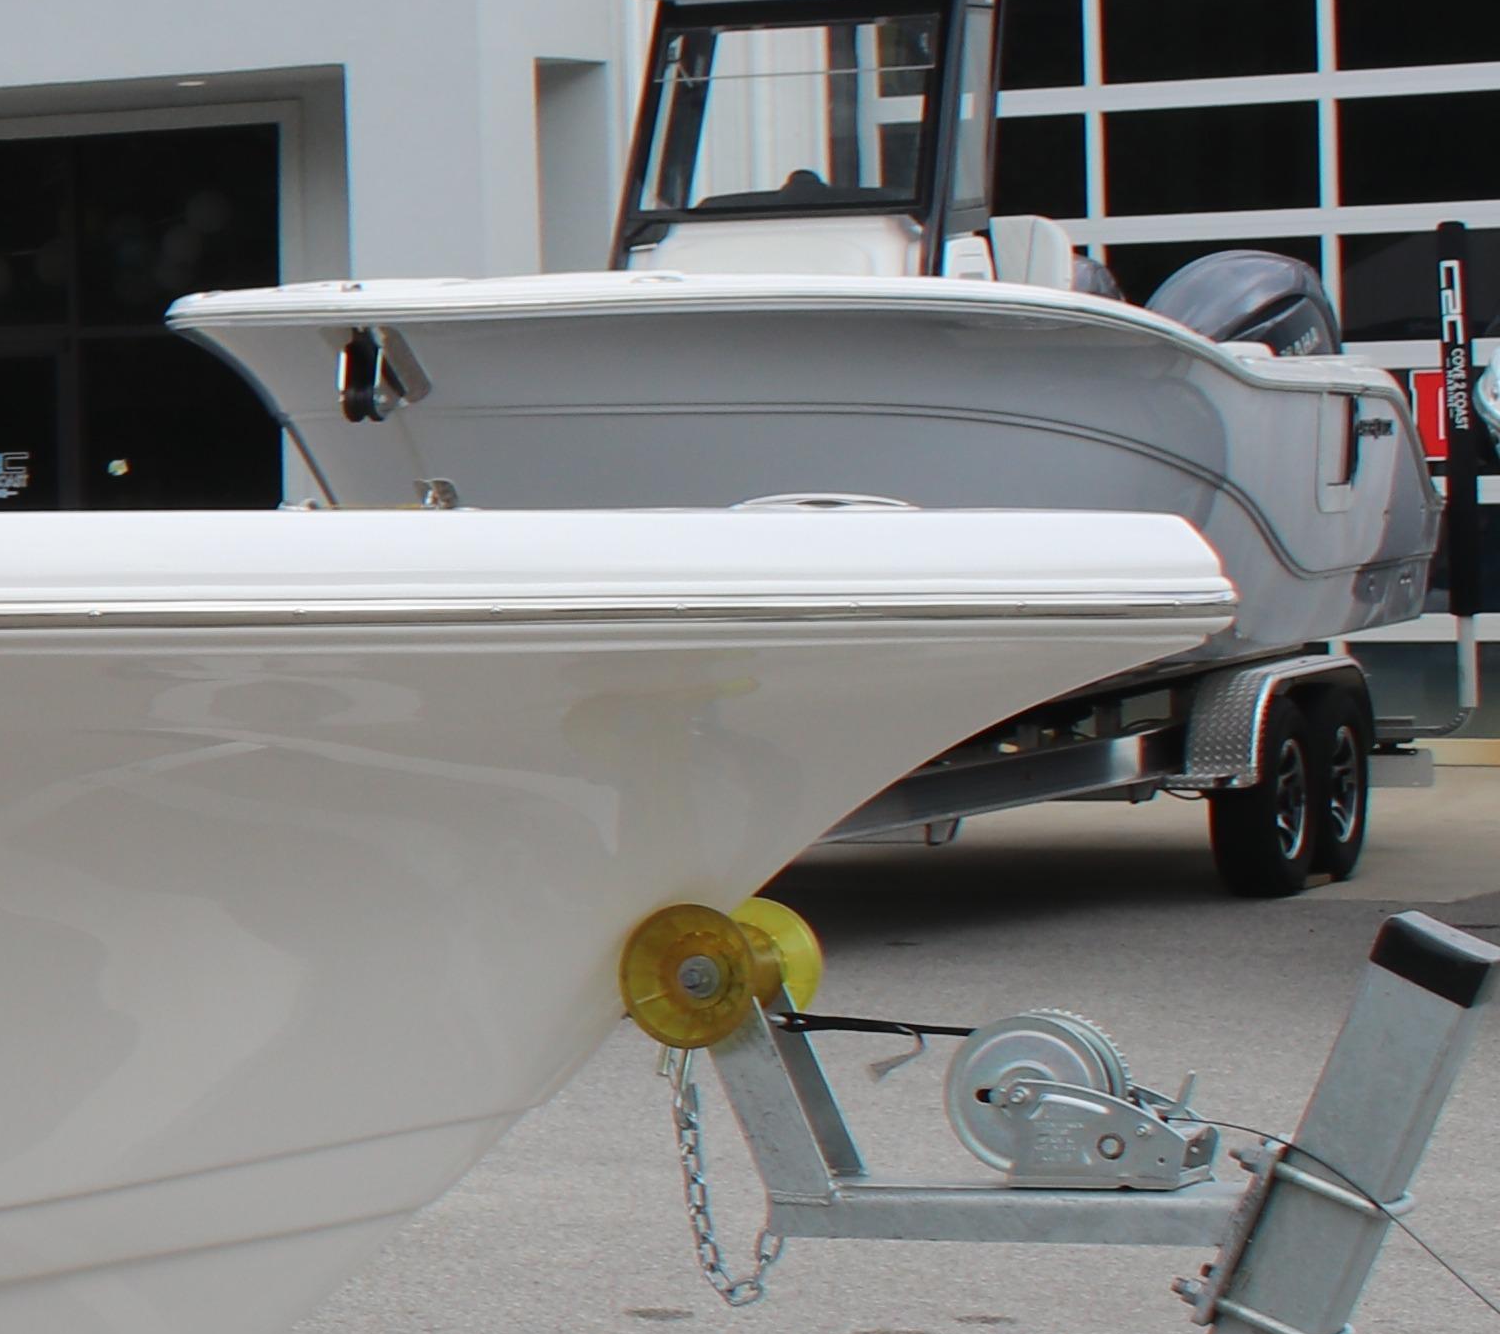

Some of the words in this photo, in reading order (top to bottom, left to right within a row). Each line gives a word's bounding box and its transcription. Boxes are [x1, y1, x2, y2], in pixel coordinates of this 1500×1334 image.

[1439, 259, 1465, 345] C2C
[1451, 347, 1466, 379] COVE
[1454, 391, 1469, 430] COAST
